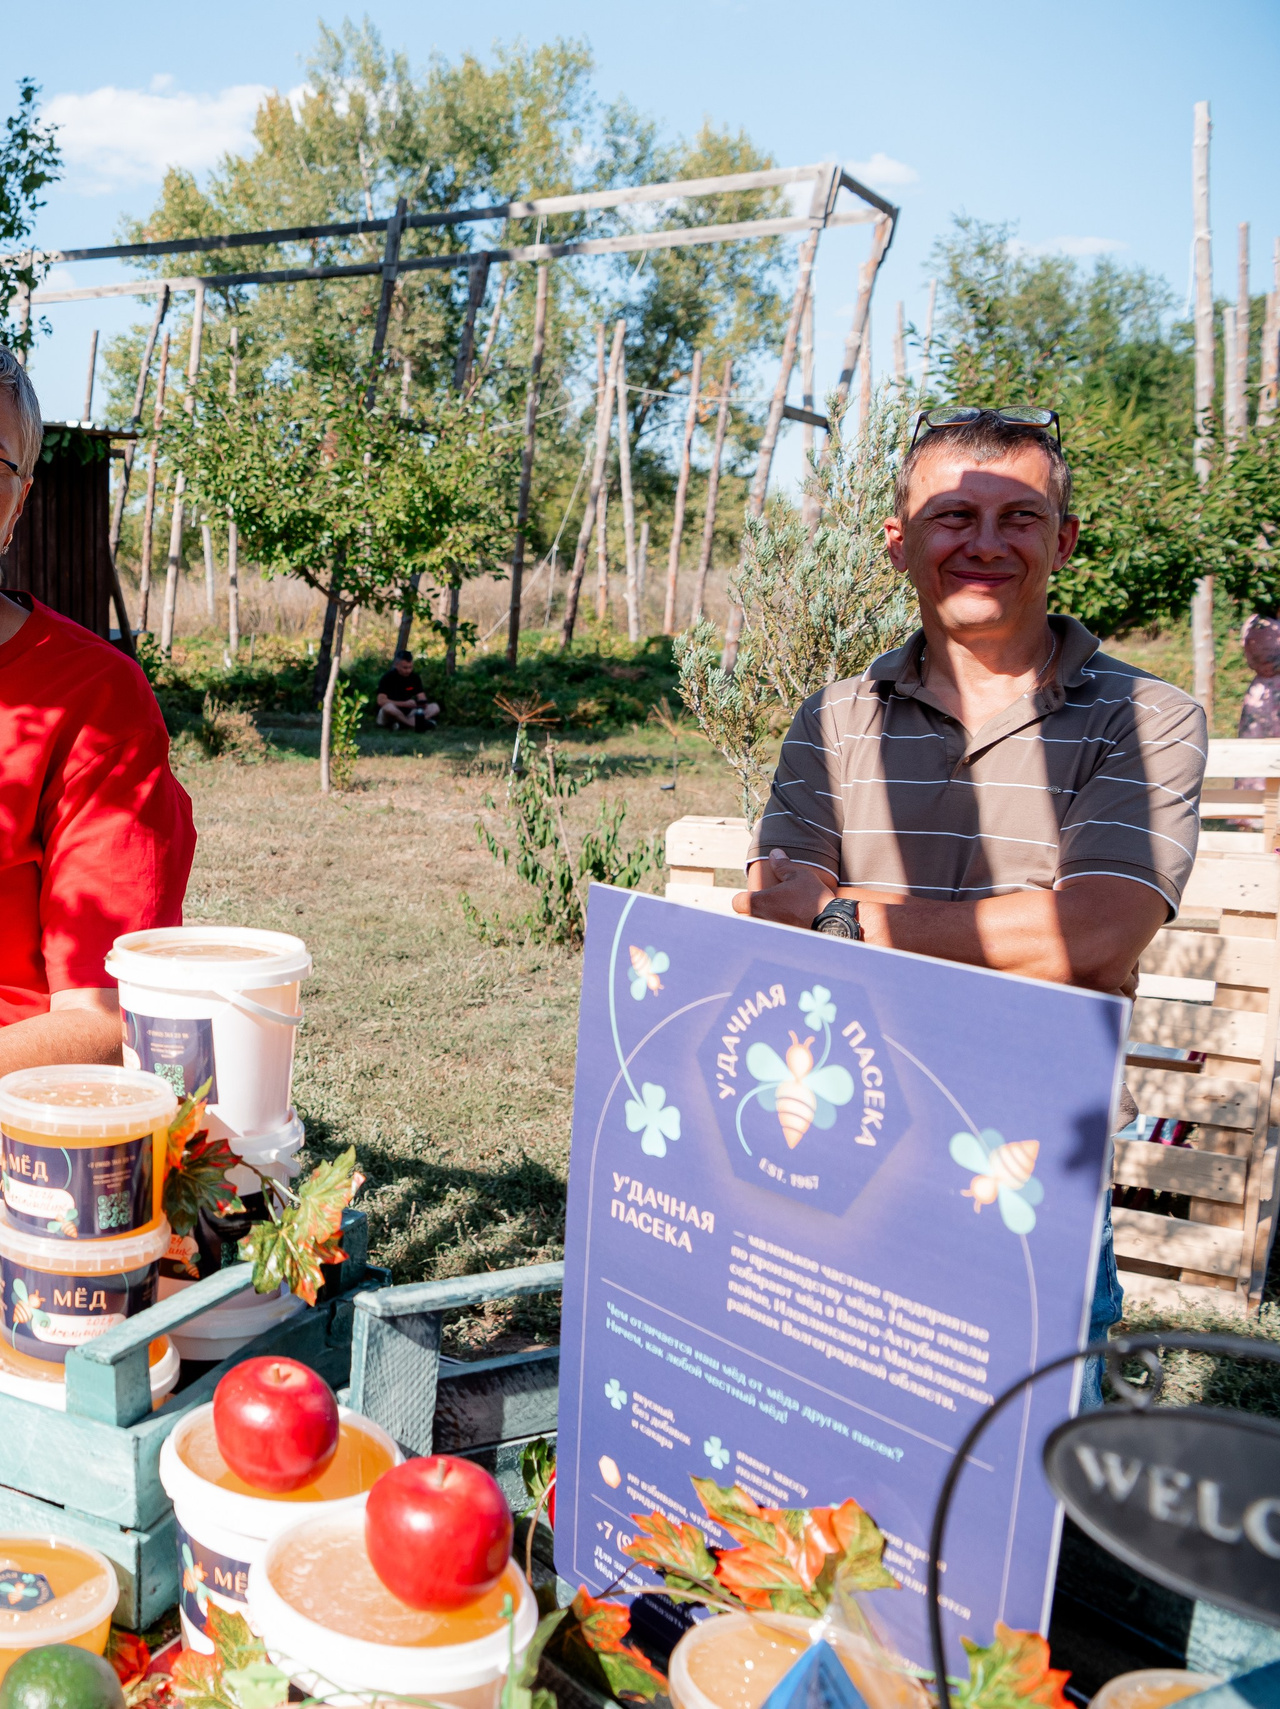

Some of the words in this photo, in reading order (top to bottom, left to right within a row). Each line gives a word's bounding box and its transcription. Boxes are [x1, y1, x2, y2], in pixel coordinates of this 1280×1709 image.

[716, 984, 786, 1101] У'ДАЧНАЯ
[841, 1020, 886, 1148] ПАСЕКА
[8, 1152, 49, 1184] МЁД
[758, 1157, 787, 1184] EST.
[790, 1173, 820, 1190] 1967
[610, 1198, 693, 1253] ПАСЕКА
[612, 1171, 716, 1234] У'ДАЧНАЯ
[53, 1287, 108, 1312] МЁД
[729, 1263, 793, 1300] собирают
[795, 1292, 824, 1316] мёд
[824, 1305, 835, 1319] в
[730, 1245, 749, 1261] по
[749, 1253, 843, 1305] производству
[888, 1309, 935, 1341] Наши
[748, 1234, 820, 1273] маленькое
[820, 1264, 881, 1299] частное
[882, 1290, 990, 1343] предприятие
[727, 1298, 780, 1332] районах
[781, 1320, 888, 1380] Волгоградской
[868, 1343, 881, 1358] и
[606, 1300, 629, 1323] Чем
[629, 1316, 693, 1356] отличается
[694, 1350, 720, 1371] наш
[722, 1364, 747, 1387] мёд
[748, 1378, 764, 1393] от
[766, 1386, 800, 1412] мёда
[801, 1405, 850, 1438] других
[851, 1429, 905, 1463] пасек?
[644, 1341, 664, 1359] как
[664, 1352, 703, 1379] любой
[703, 1372, 757, 1408] честный
[631, 1402, 650, 1422] без
[595, 1520, 614, 1540] +7
[213, 1566, 248, 1594] МЁ
